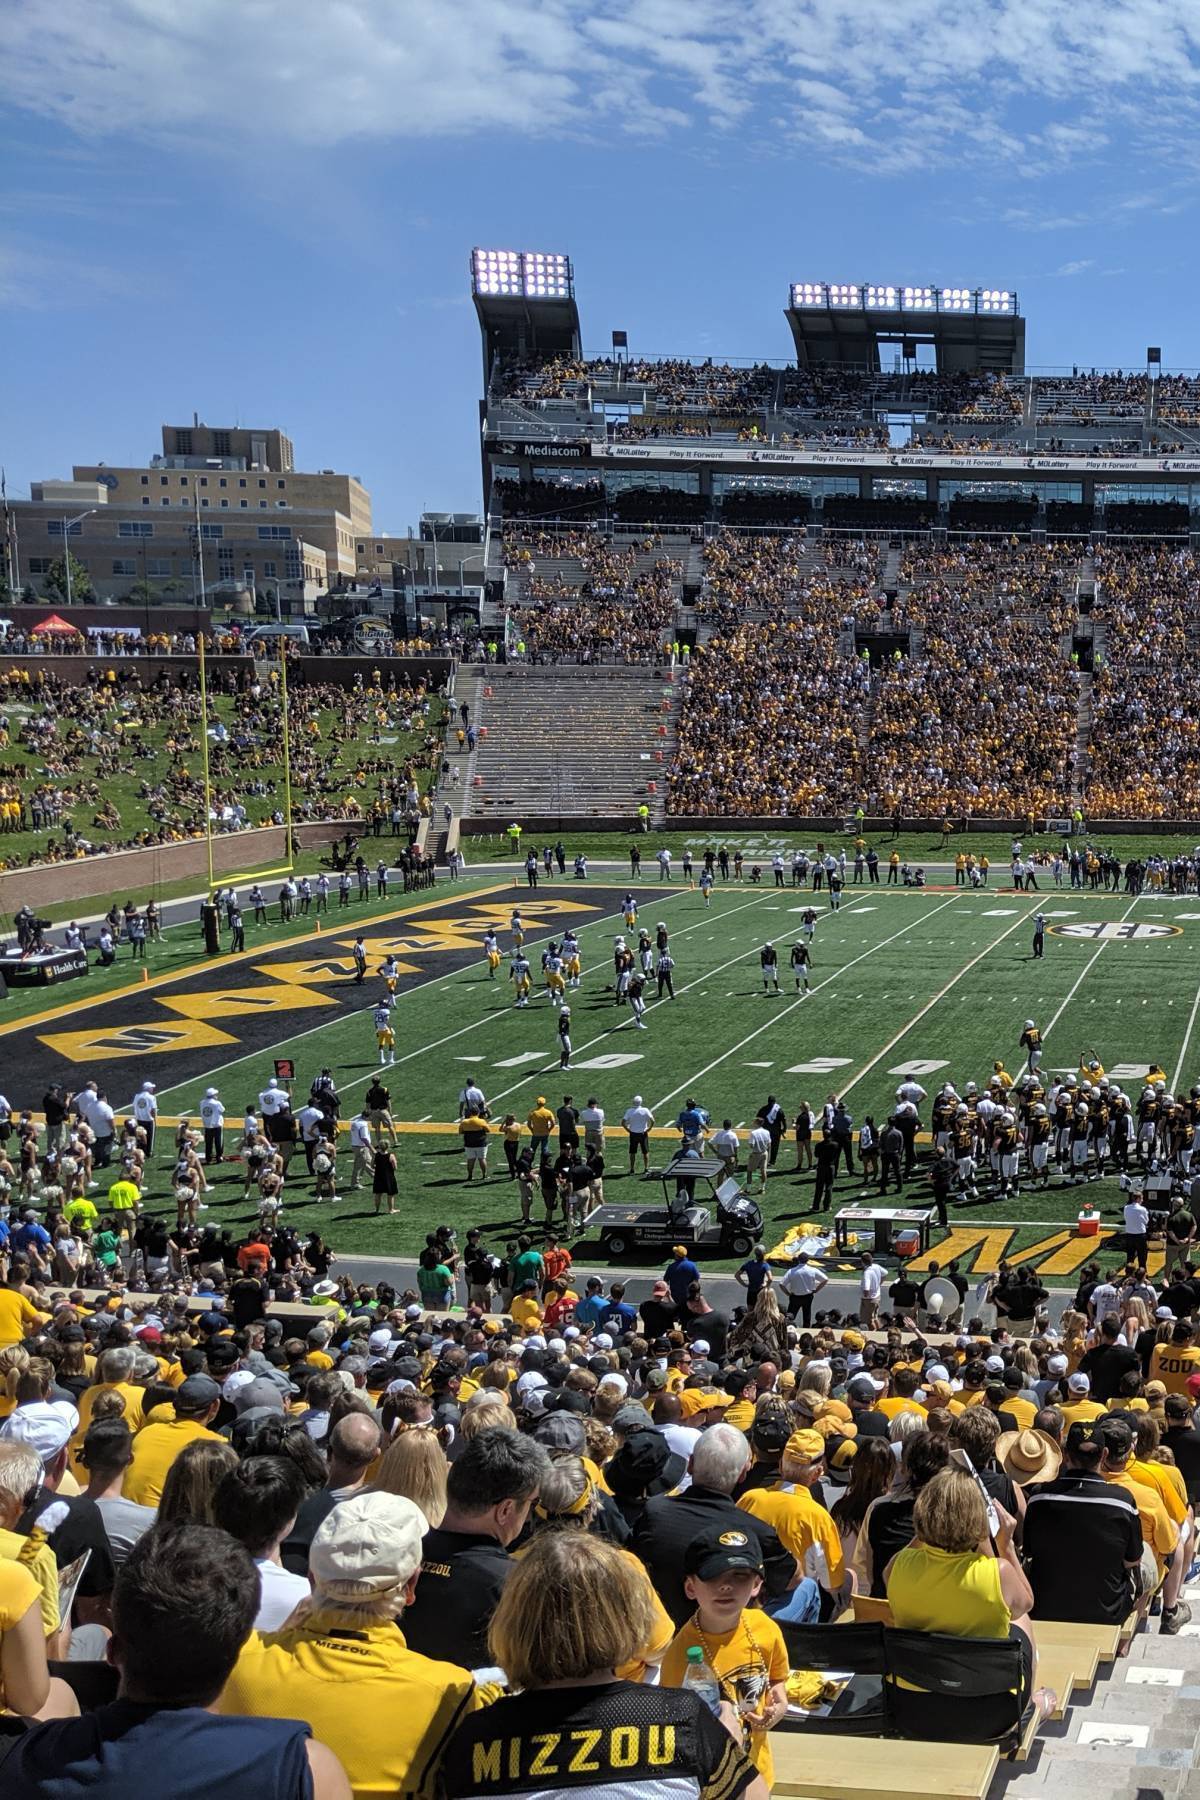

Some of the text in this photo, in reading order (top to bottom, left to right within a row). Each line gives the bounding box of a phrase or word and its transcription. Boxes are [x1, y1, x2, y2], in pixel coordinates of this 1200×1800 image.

[524, 444, 580, 458] Mediacom
[1059, 922, 1174, 940] SEC
[52, 962, 74, 976] Health
[276, 1062, 291, 1078] 2
[1158, 1356, 1194, 1374] ZOU
[315, 1639, 369, 1656] MIZZOU
[472, 1724, 675, 1784] MIZZOU
